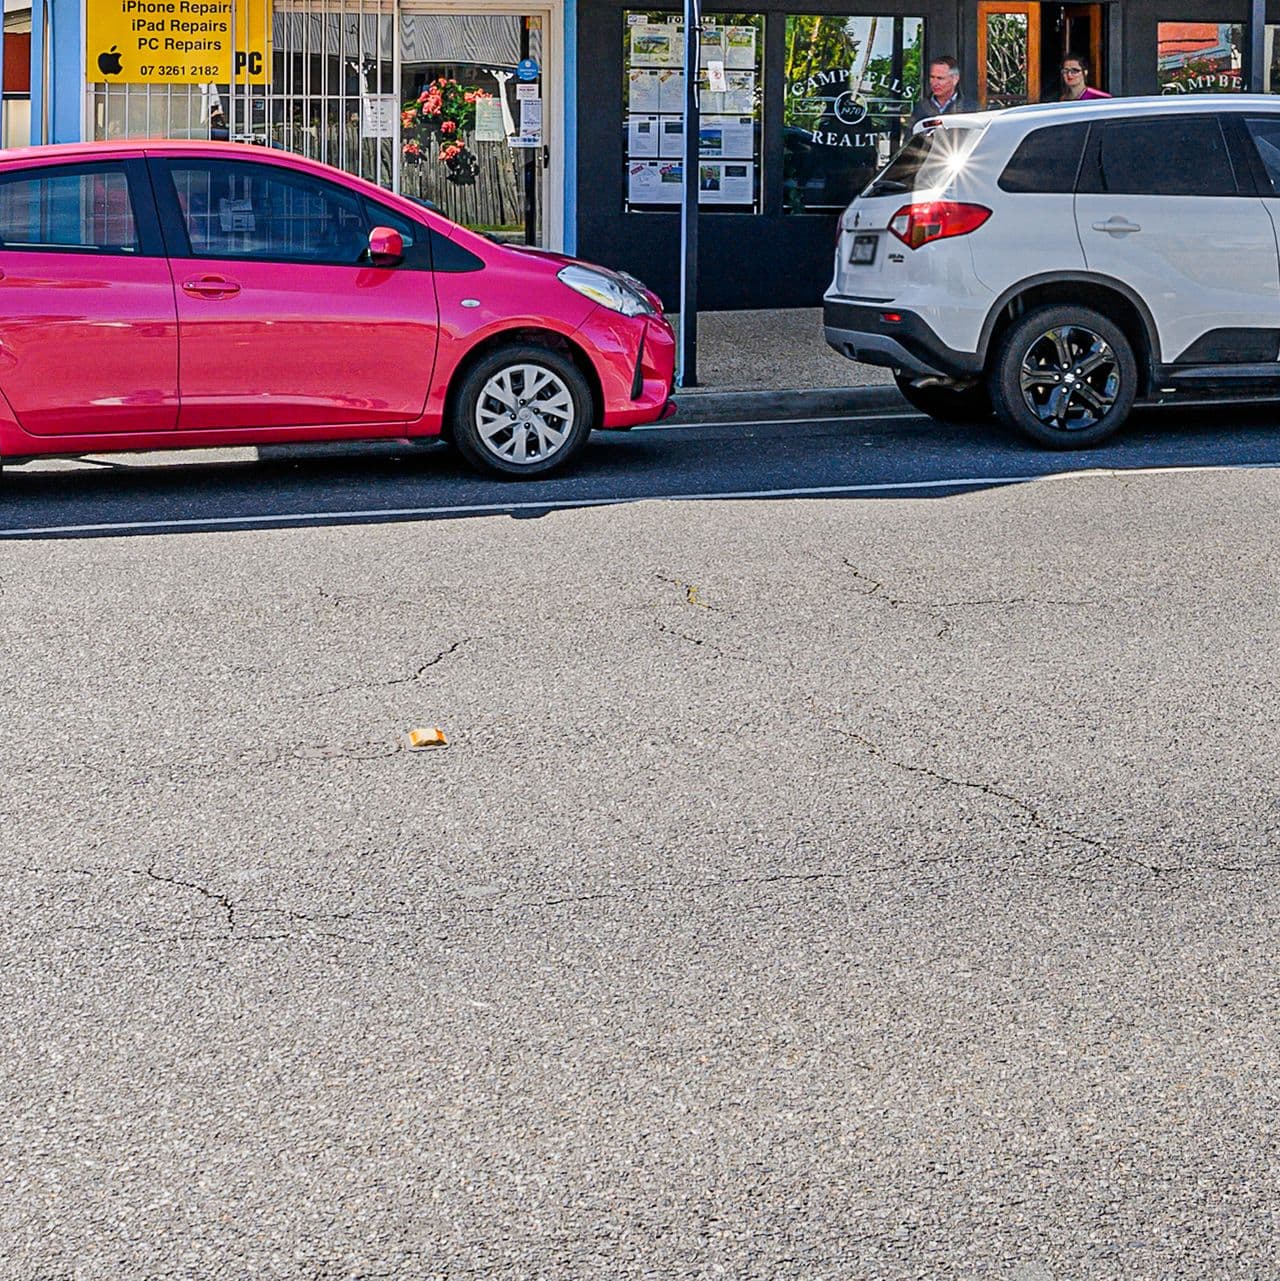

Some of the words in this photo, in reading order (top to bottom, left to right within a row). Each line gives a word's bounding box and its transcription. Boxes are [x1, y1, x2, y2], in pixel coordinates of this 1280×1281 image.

[122, 0, 176, 14] iPhone
[179, 1, 237, 16] Repairs
[131, 19, 165, 32] iPad
[170, 20, 228, 34] Repairs
[137, 37, 159, 50] PC
[164, 37, 222, 53] Repairs
[140, 66, 155, 76] 07
[158, 66, 186, 76] 3261
[190, 66, 219, 76] 2182
[235, 51, 262, 76] PC
[791, 68, 915, 99] CAMPELLS
